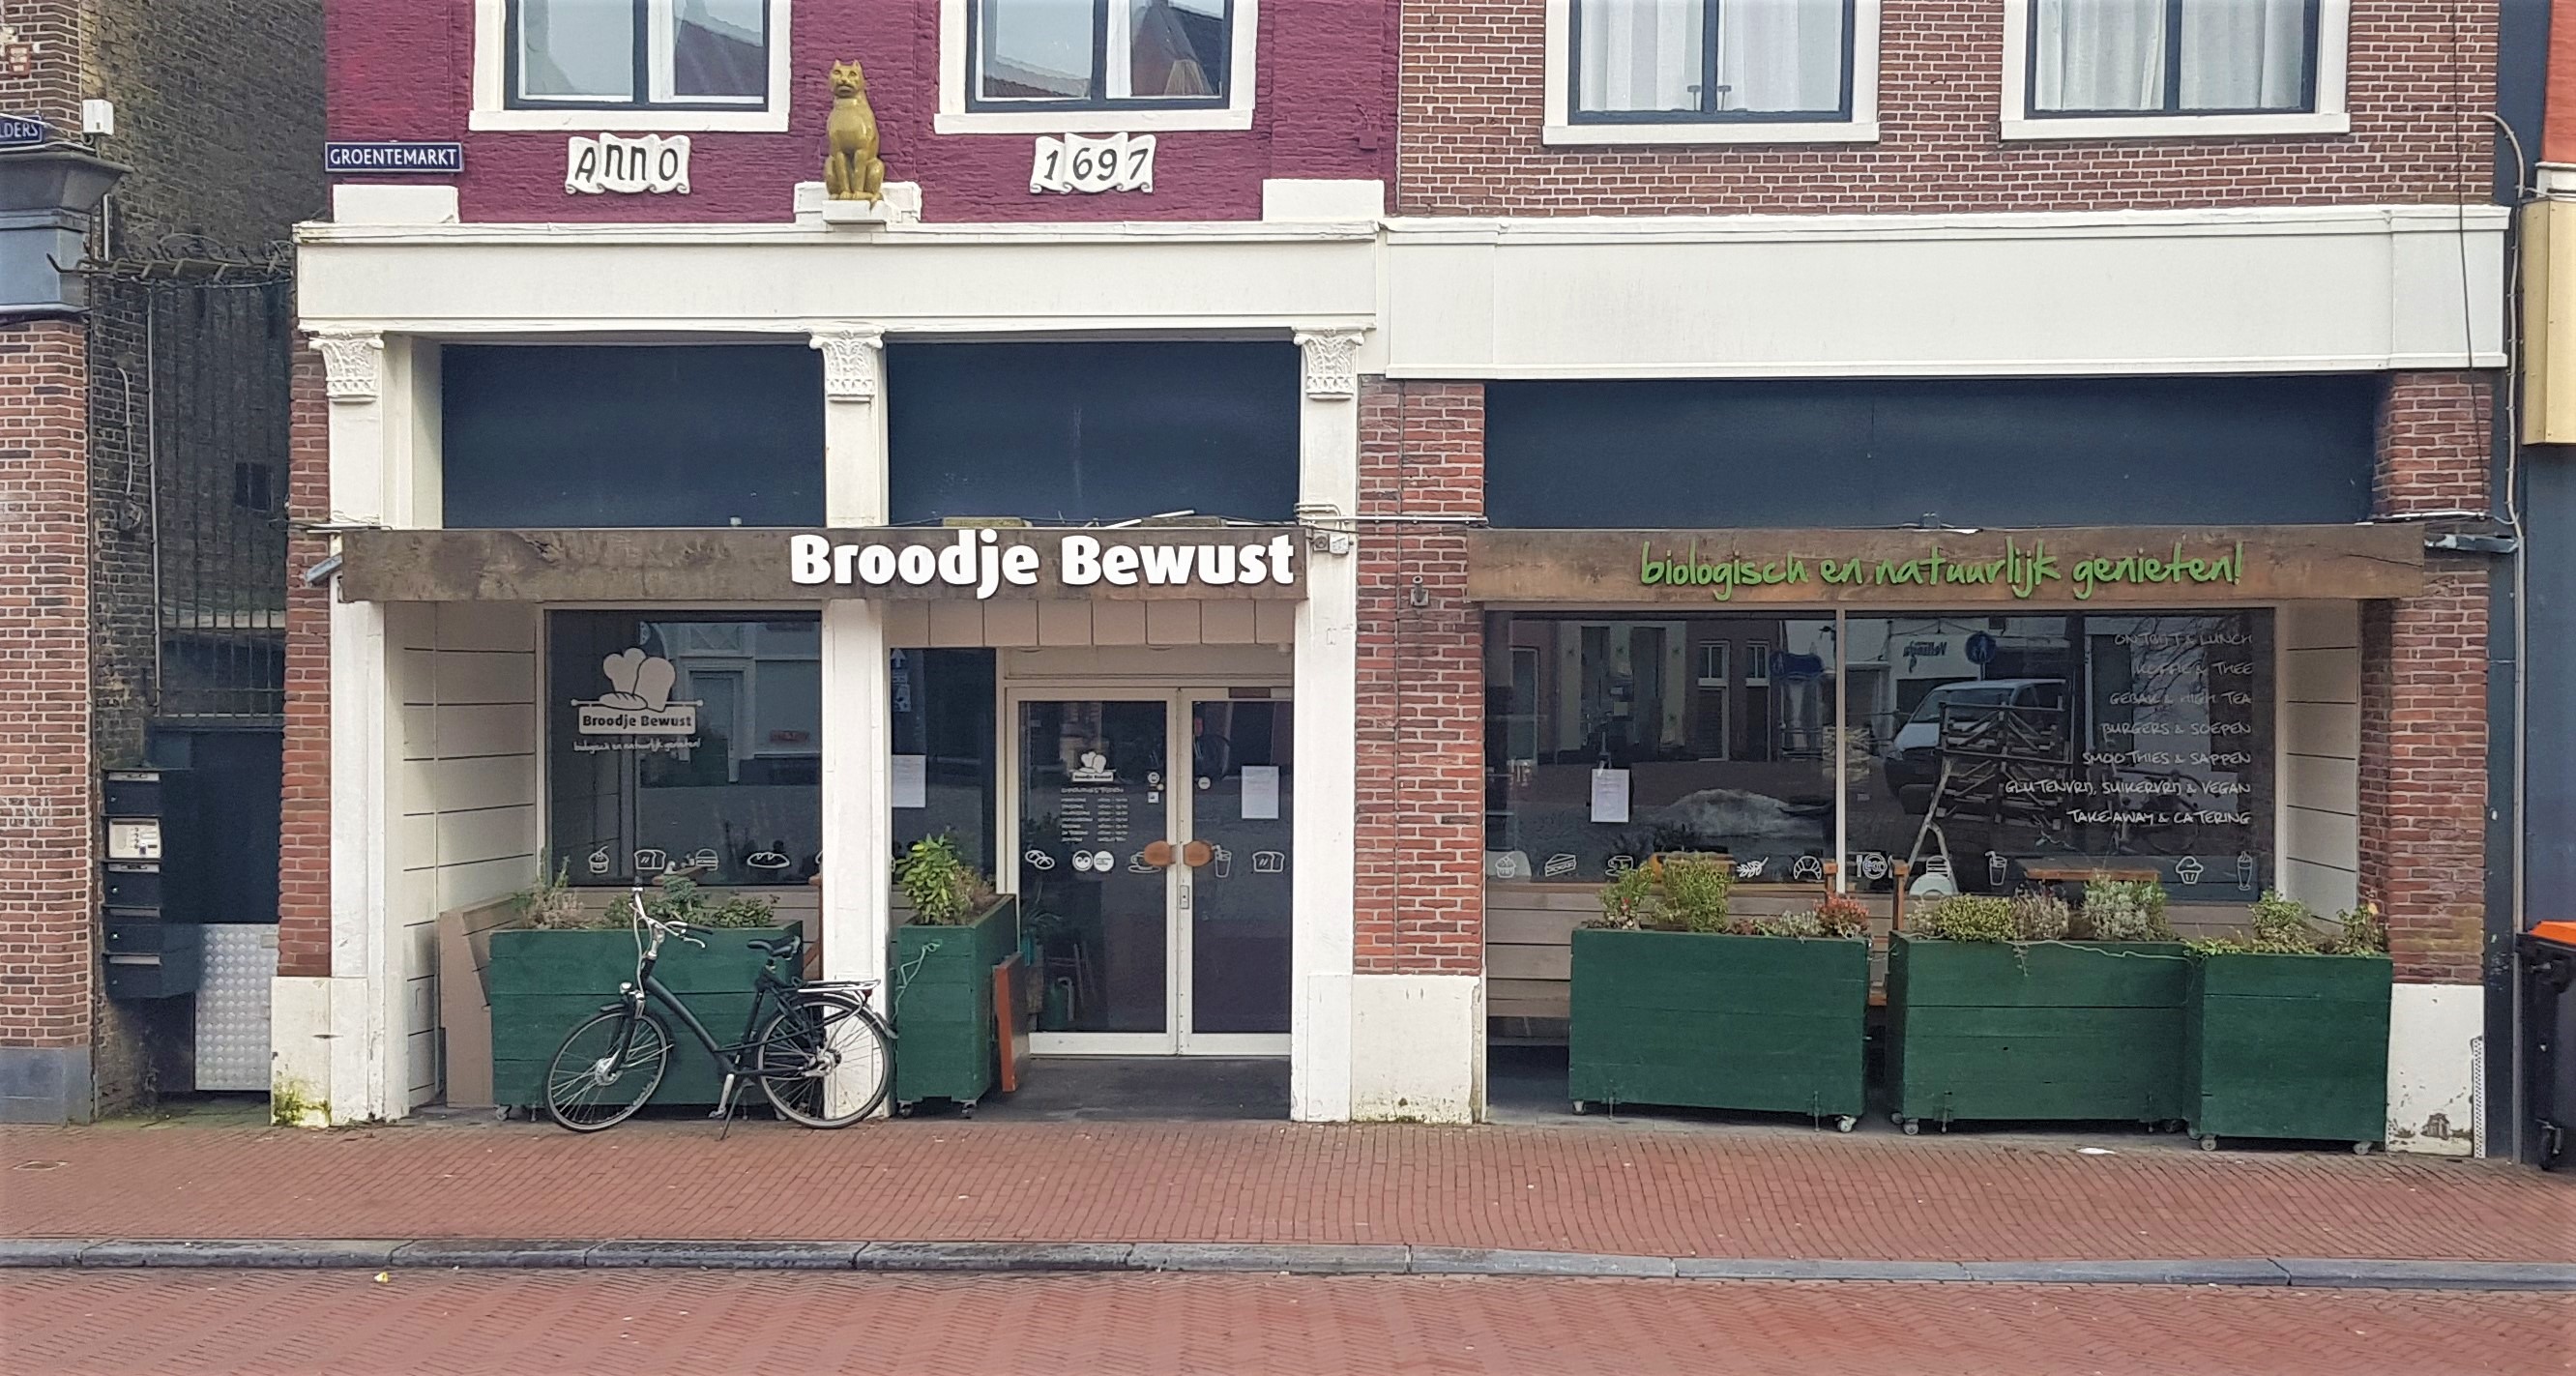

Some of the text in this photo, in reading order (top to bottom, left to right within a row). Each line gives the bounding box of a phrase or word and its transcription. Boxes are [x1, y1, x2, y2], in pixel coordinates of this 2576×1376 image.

[330, 148, 457, 166] GROENTEMARKT
[1043, 147, 1149, 181] 1697
[790, 529, 1294, 600] Broodje Bewust
[1641, 536, 2244, 601] biologisch en natuurlijk genieten!
[2200, 633, 2253, 646] LUNCH
[2211, 661, 2254, 676] THEE
[2109, 692, 2161, 705] GEBAK
[2181, 692, 2216, 705] HIGH
[2221, 690, 2252, 705] TEA
[582, 715, 691, 730] Broodje Bewust
[2101, 721, 2251, 735] BURGERS & SOEPEN
[2175, 755, 2185, 764] &
[2190, 751, 2251, 765] SAPPEN
[2185, 782, 2197, 794] &
[2201, 780, 2251, 794] VEGAN
[2157, 812, 2169, 823] &
[2174, 809, 2252, 825] CATERING
